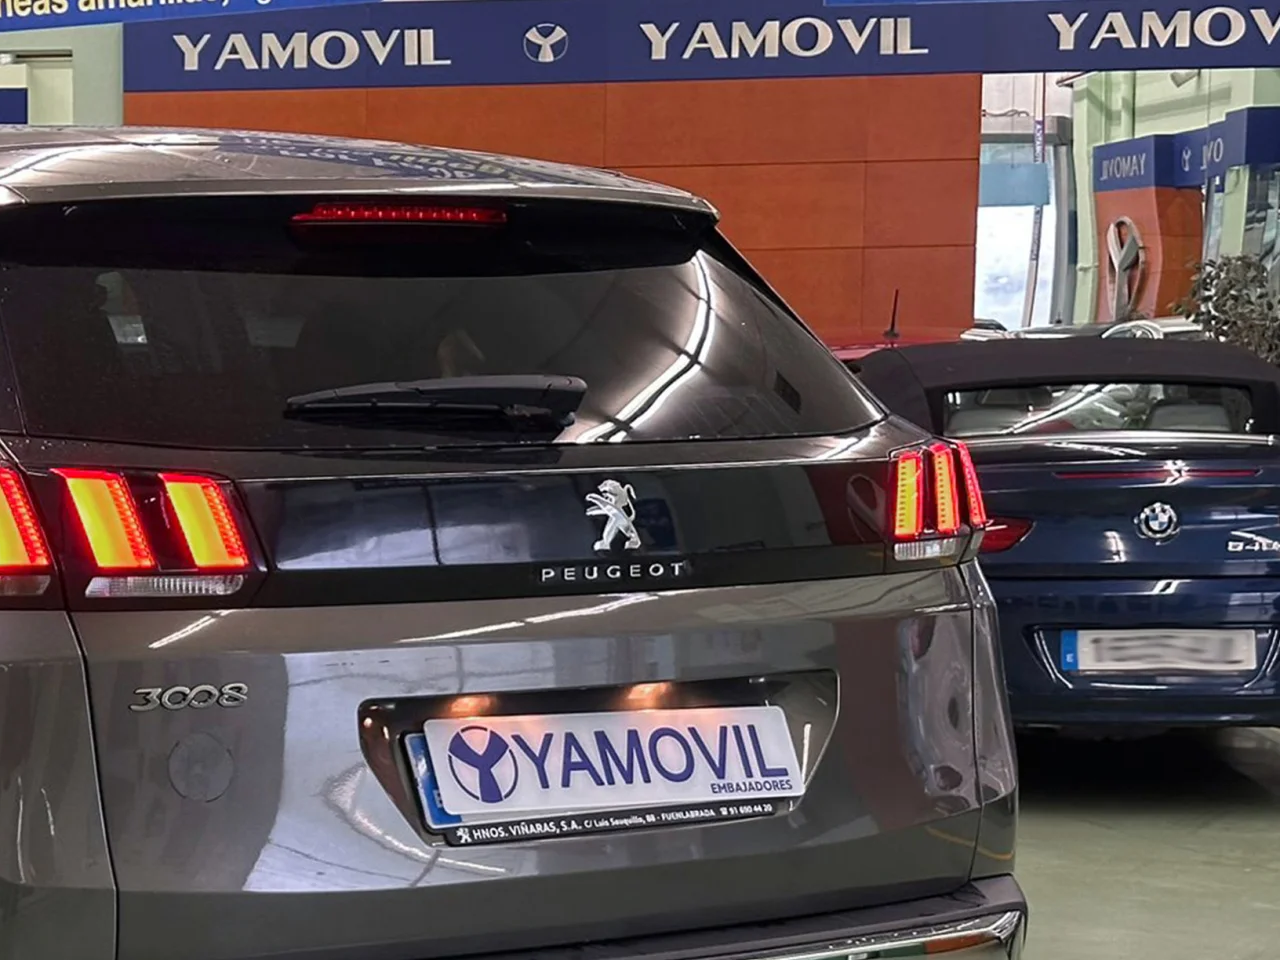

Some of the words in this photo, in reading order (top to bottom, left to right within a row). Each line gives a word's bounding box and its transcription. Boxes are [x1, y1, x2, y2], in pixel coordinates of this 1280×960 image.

[172, 28, 452, 71] YAMOVIL
[639, 16, 929, 60] YAMOVIL
[541, 562, 684, 582] PEUGEOT
[129, 682, 249, 711] 3008
[512, 724, 788, 789] YAMOVIL
[710, 779, 793, 794] EMBAJADORES
[472, 826, 508, 841] HNOS.
[508, 821, 560, 836] VIÑARAS,
[561, 819, 582, 832] S.A.
[661, 808, 716, 821] FUENLABRADA
